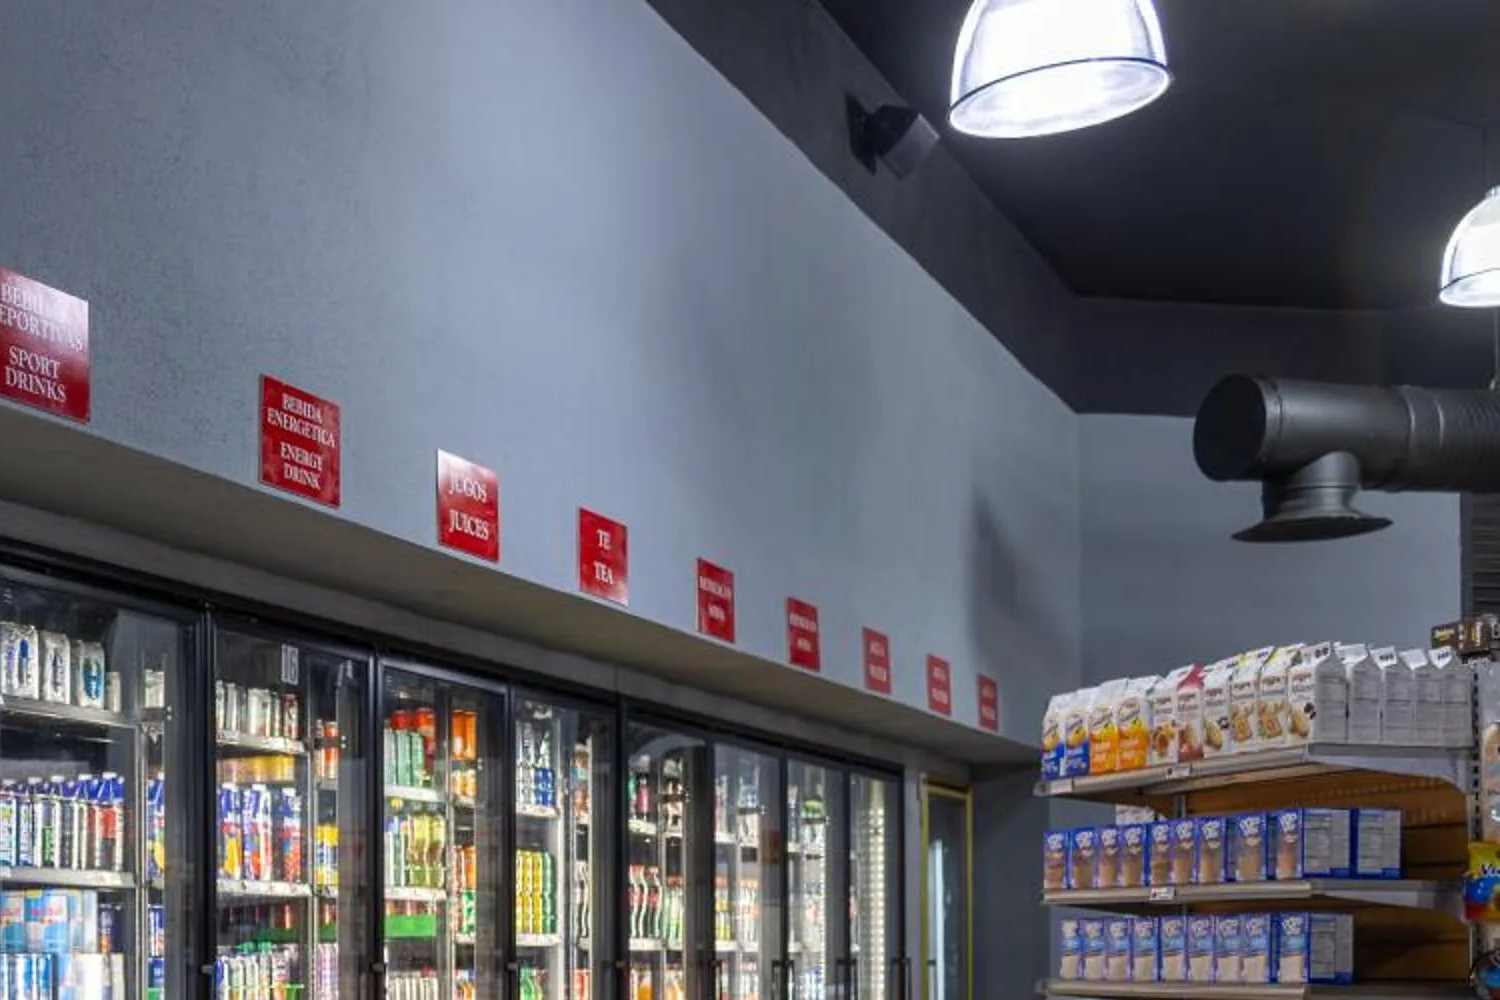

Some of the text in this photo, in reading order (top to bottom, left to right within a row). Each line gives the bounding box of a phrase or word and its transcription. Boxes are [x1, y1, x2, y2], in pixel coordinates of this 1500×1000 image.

[8, 346, 61, 379] SPORT
[4, 366, 67, 402] DRINKS
[283, 462, 321, 490] DRINK
[448, 472, 488, 503] JUGOS
[449, 510, 489, 541] JUICES
[593, 561, 613, 584] TEA
